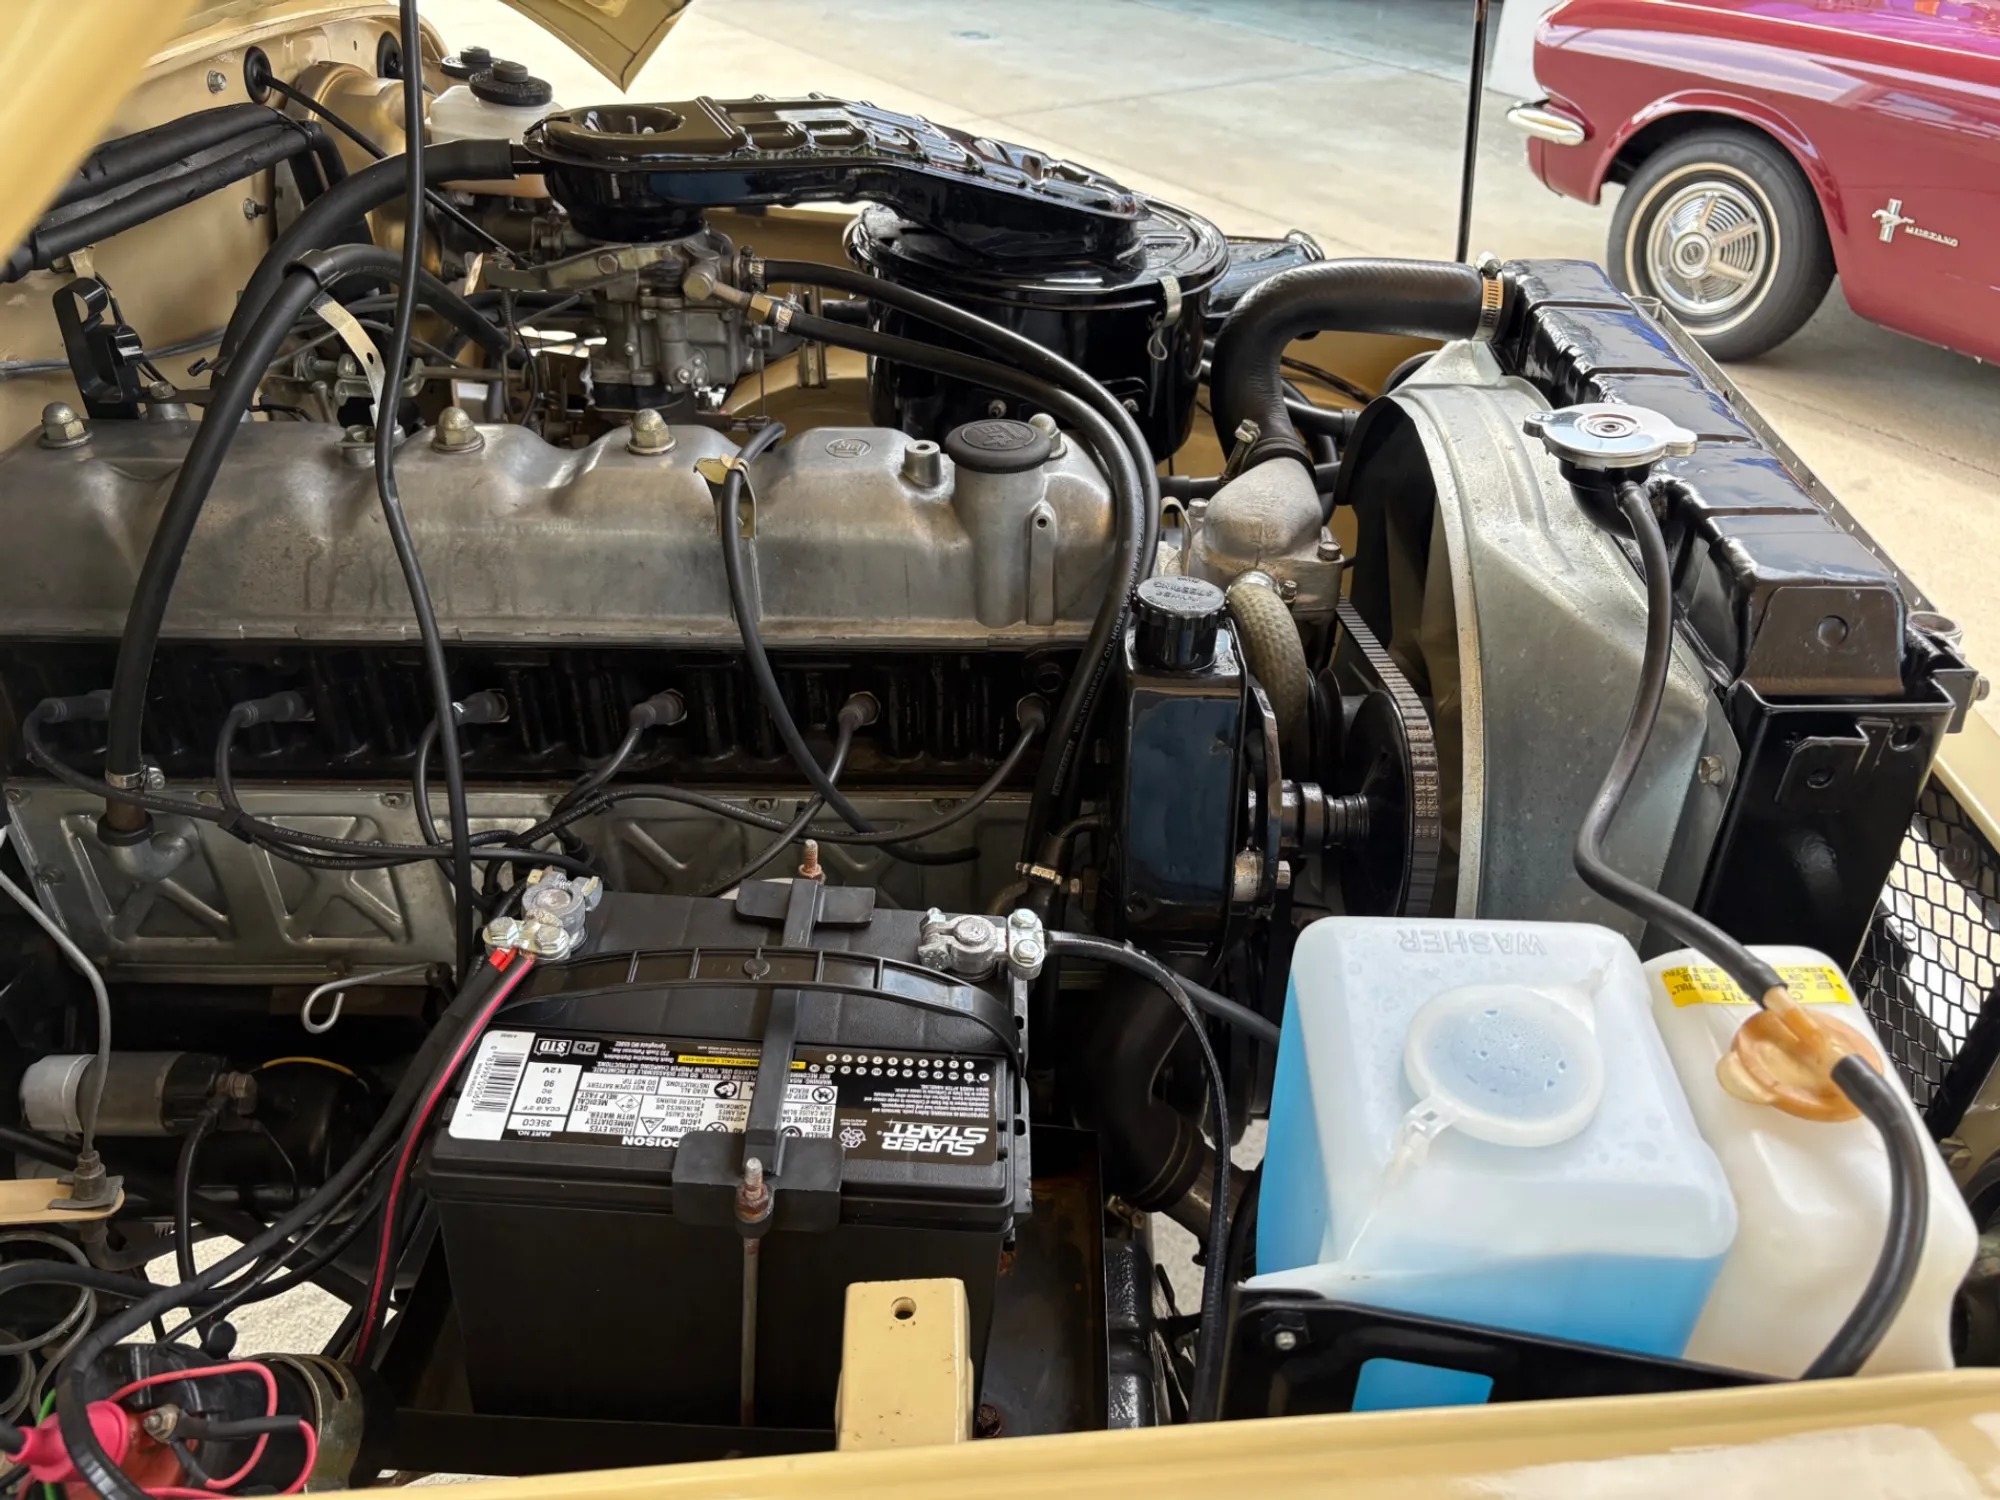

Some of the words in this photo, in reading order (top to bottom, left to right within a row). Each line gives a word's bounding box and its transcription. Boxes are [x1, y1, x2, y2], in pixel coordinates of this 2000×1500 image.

[1110, 611, 1126, 642] HOSE
[1396, 929, 1547, 956] WASHER
[540, 1041, 567, 1052] STD
[577, 1043, 595, 1053] Pb
[664, 1080, 710, 1088] INSTRUCTIONS.
[577, 1098, 609, 1107] MEDICAL
[678, 1098, 702, 1106] SEVERE
[588, 1111, 615, 1119] WATER.
[522, 1119, 552, 1127] 35ECO
[584, 1118, 634, 1127] IMMEDIATELY
[793, 1116, 832, 1124] EXPLOSIVE
[608, 1126, 633, 1134] FLUSH
[661, 1125, 696, 1133] SULFURIC
[883, 1123, 989, 1144] START
[622, 1136, 680, 1148] POISON
[882, 1137, 976, 1156] SUPER
